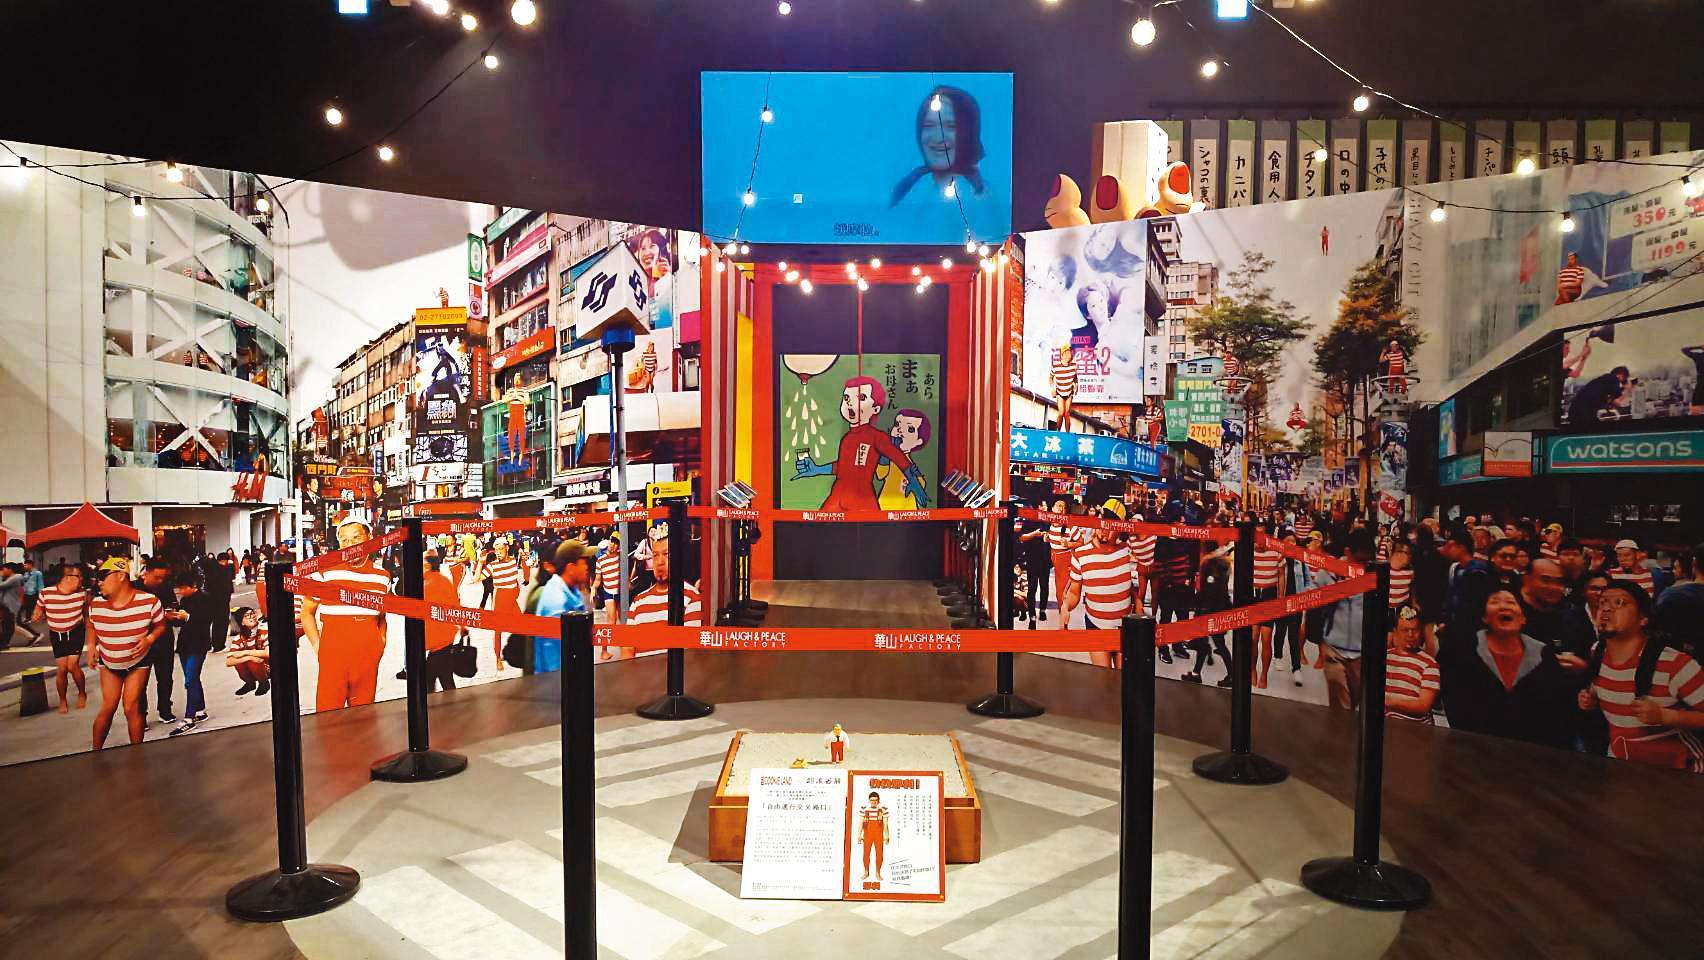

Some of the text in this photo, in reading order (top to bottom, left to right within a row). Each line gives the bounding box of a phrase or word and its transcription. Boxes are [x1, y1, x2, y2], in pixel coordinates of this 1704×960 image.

[1268, 150, 1281, 202] 食用人
[1340, 150, 1351, 194] 口の中
[1373, 147, 1387, 190] 子供の
[885, 363, 898, 409] お母さん
[924, 373, 935, 399] あら
[1567, 439, 1692, 459] watsons
[286, 577, 299, 586] PEACE
[352, 592, 366, 600] LAUGH
[370, 594, 384, 605] PEACE
[431, 605, 444, 621] 華山
[445, 609, 461, 618] LAUGH
[466, 611, 481, 620] PEACE
[445, 617, 481, 626] FACTORY
[700, 631, 722, 647] 華山
[725, 631, 753, 642] LAUGH
[761, 632, 786, 642] PEACE
[874, 633, 897, 649] 華山
[900, 633, 928, 643] LAUGH
[936, 634, 960, 643] PEACE
